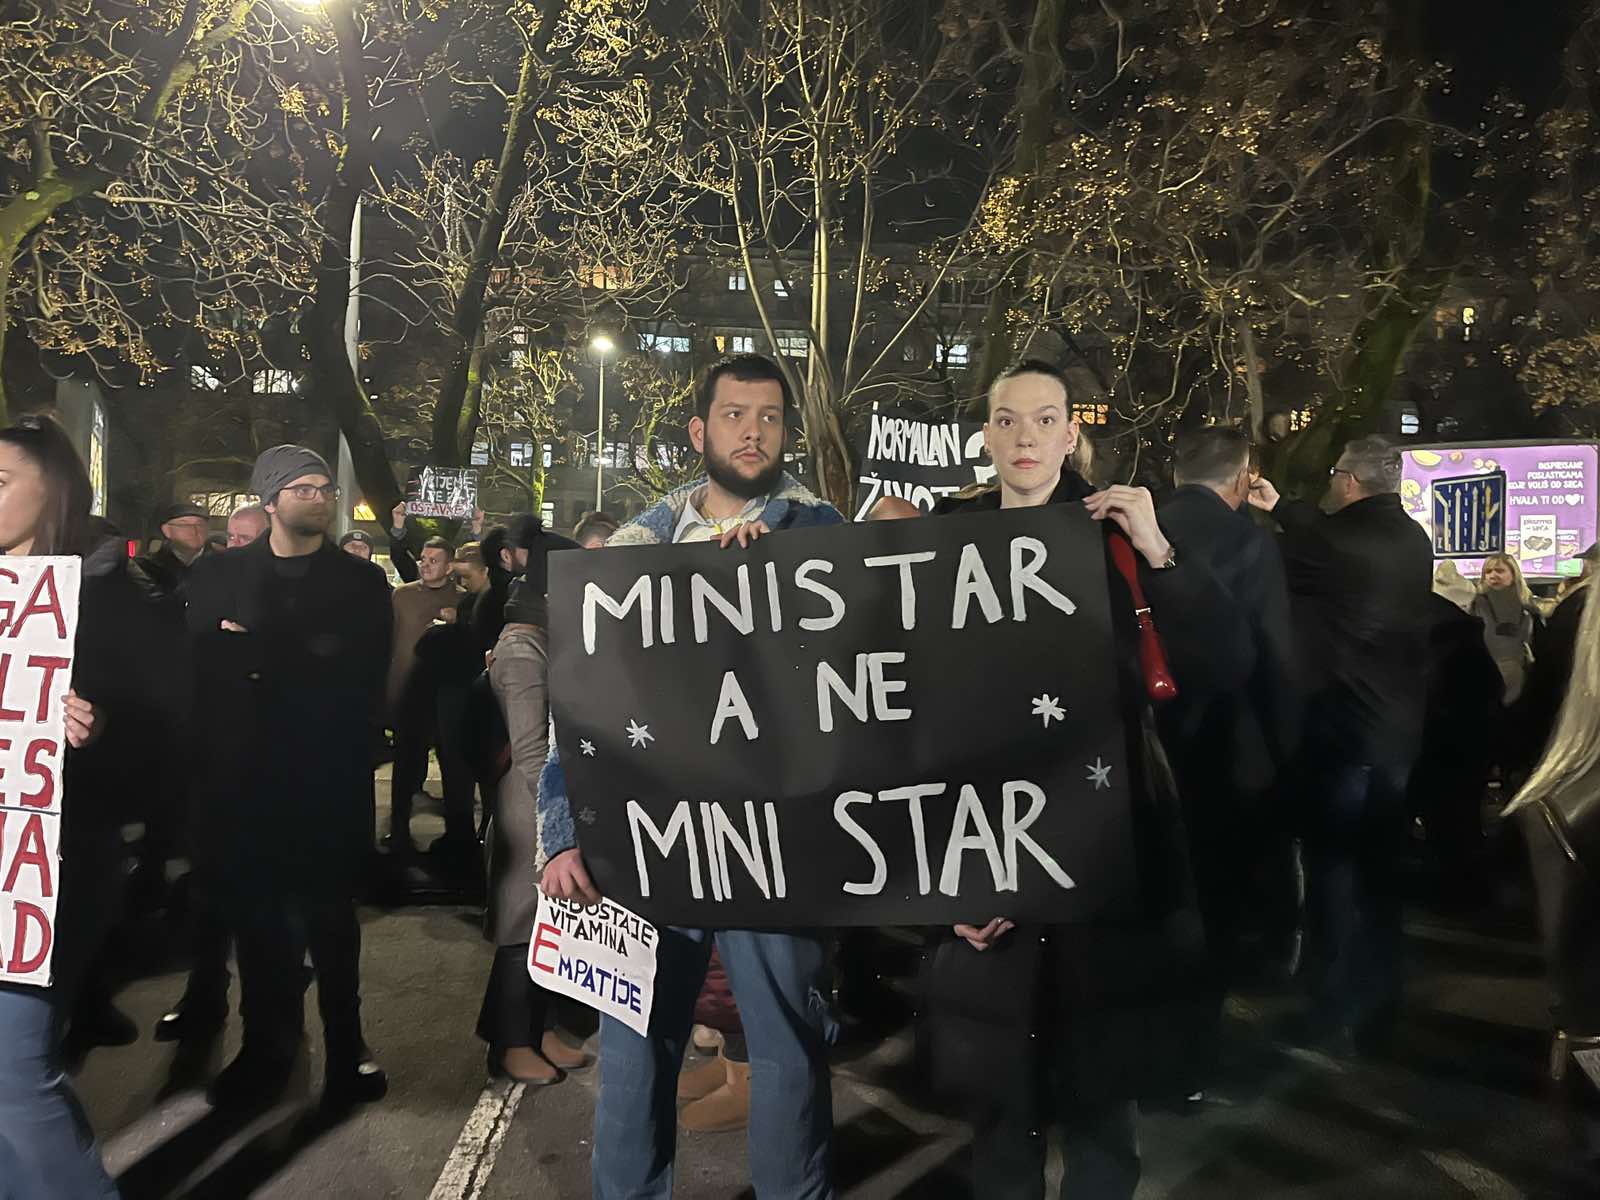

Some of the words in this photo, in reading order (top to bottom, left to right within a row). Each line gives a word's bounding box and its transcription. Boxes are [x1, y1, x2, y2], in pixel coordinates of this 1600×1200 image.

[867, 413, 962, 468] NORMALAN
[854, 471, 961, 522] ŽVO
[1509, 495, 1539, 505] HVALA
[1540, 495, 1550, 505] TI
[1551, 495, 1565, 505] OD
[582, 536, 1077, 655] MINISTAR
[709, 670, 760, 745] A
[815, 651, 913, 733] NE
[626, 800, 787, 902] MINI
[832, 779, 1076, 897] STAR
[531, 921, 642, 1016] EMPATIJE
[549, 905, 629, 958] VITAMINA
